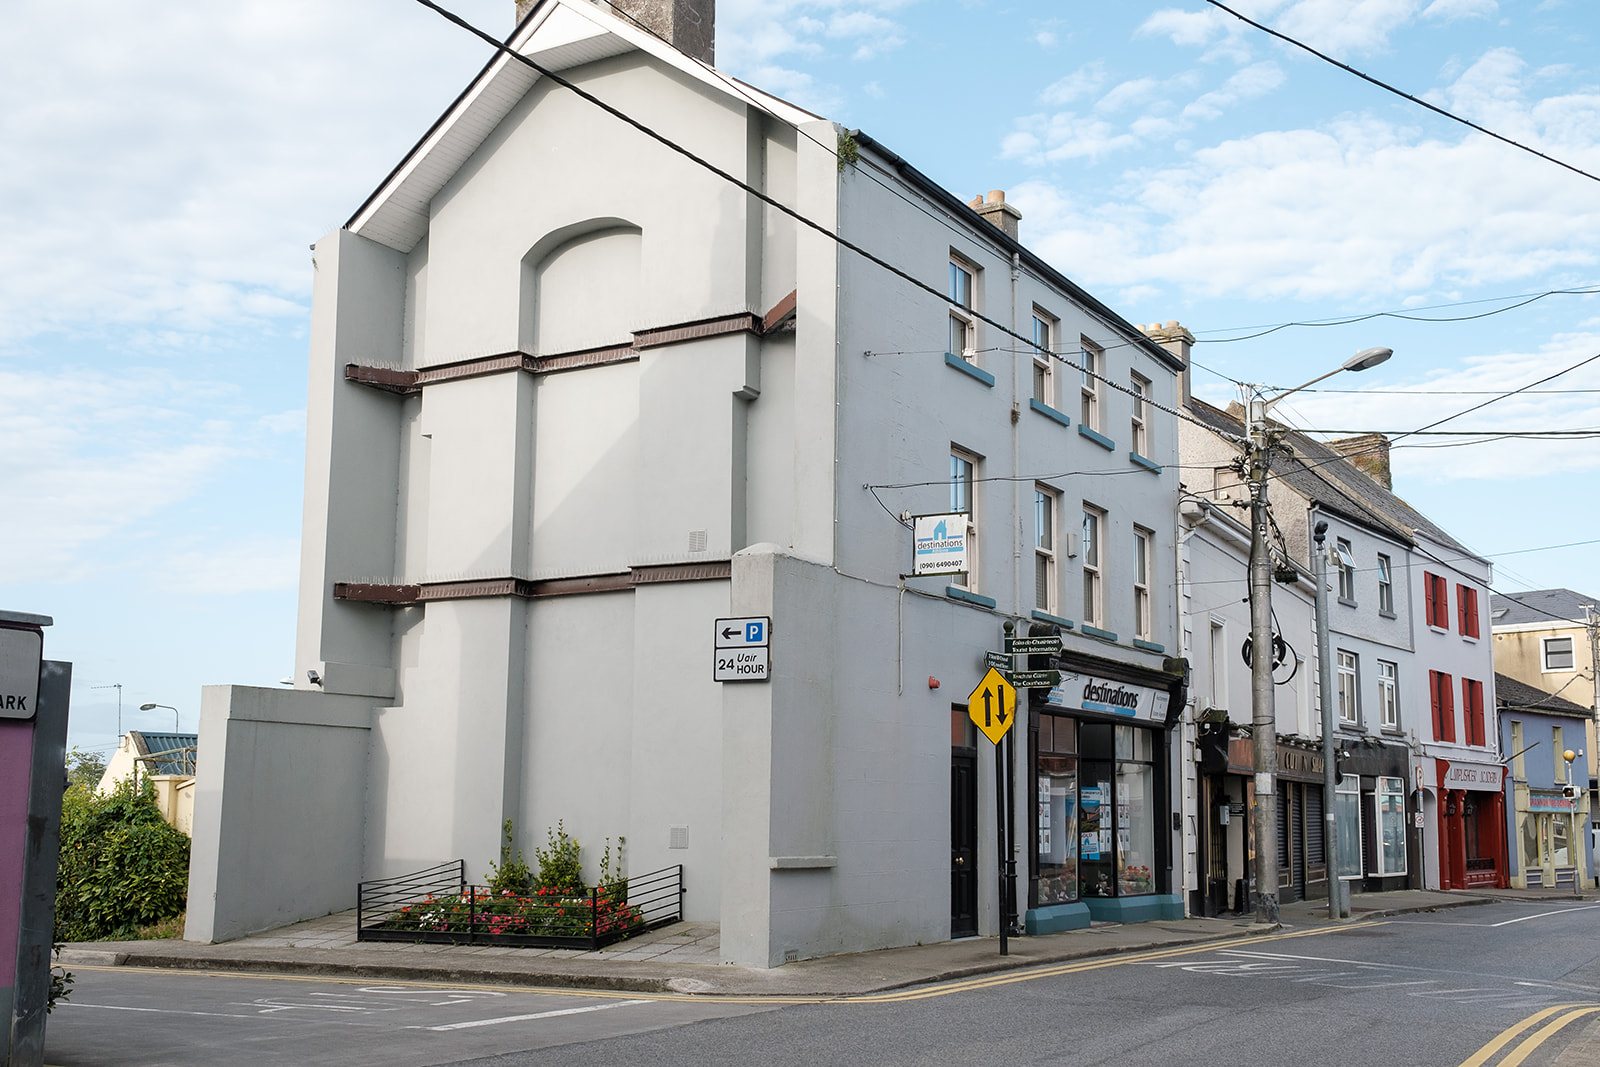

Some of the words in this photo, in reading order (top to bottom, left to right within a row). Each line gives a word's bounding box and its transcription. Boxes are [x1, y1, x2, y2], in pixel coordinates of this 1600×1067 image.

[917, 540, 963, 549] destinations
[936, 560, 962, 568] 6490407
[718, 658, 735, 671] 24
[737, 653, 757, 663] Uair
[737, 664, 764, 674] HOUR
[1083, 678, 1139, 709] destinations
